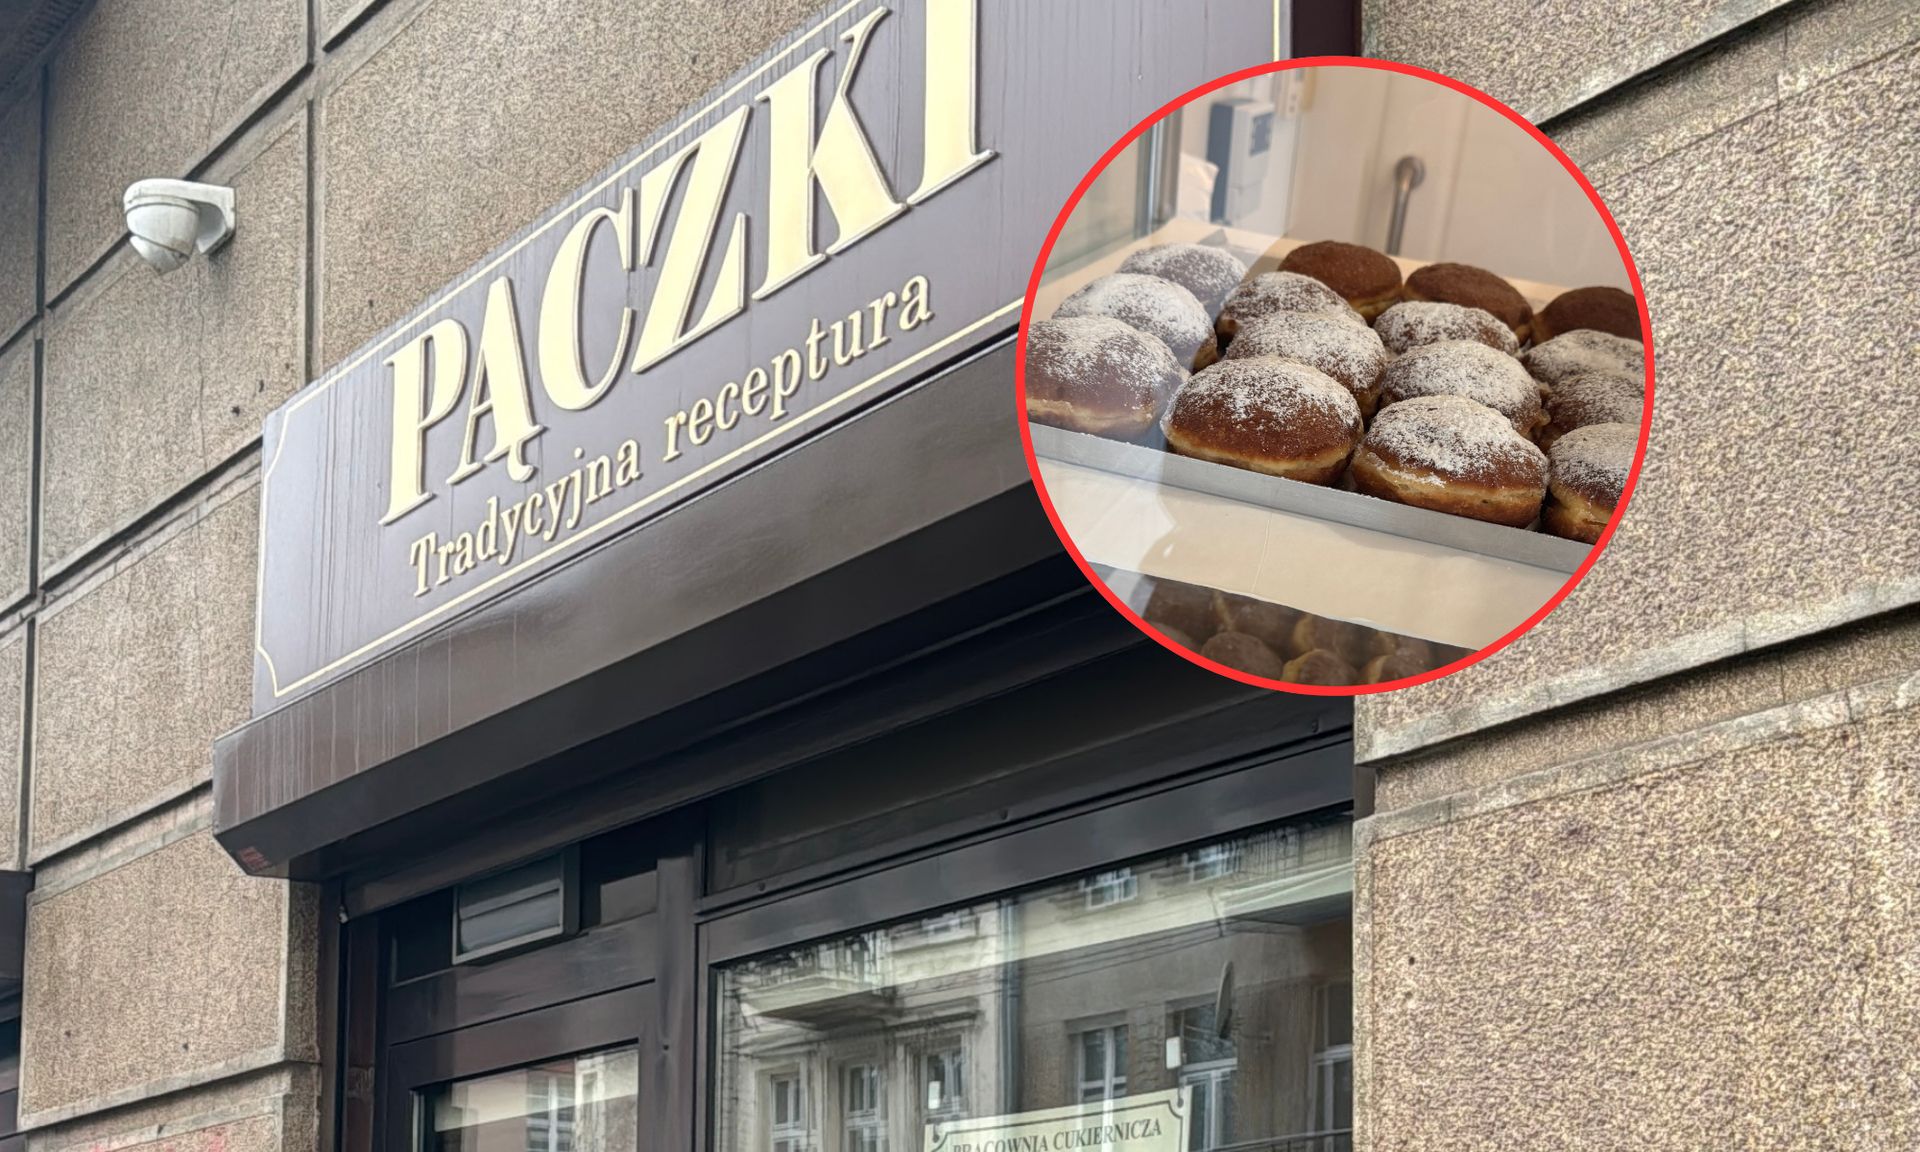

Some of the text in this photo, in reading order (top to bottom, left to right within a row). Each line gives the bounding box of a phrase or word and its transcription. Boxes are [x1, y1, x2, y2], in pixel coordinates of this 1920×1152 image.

[379, 0, 998, 526] PĄCZKI
[409, 274, 932, 598] Tradycyjna receptura
[1053, 1118, 1162, 1151] CUKIERNICZA
